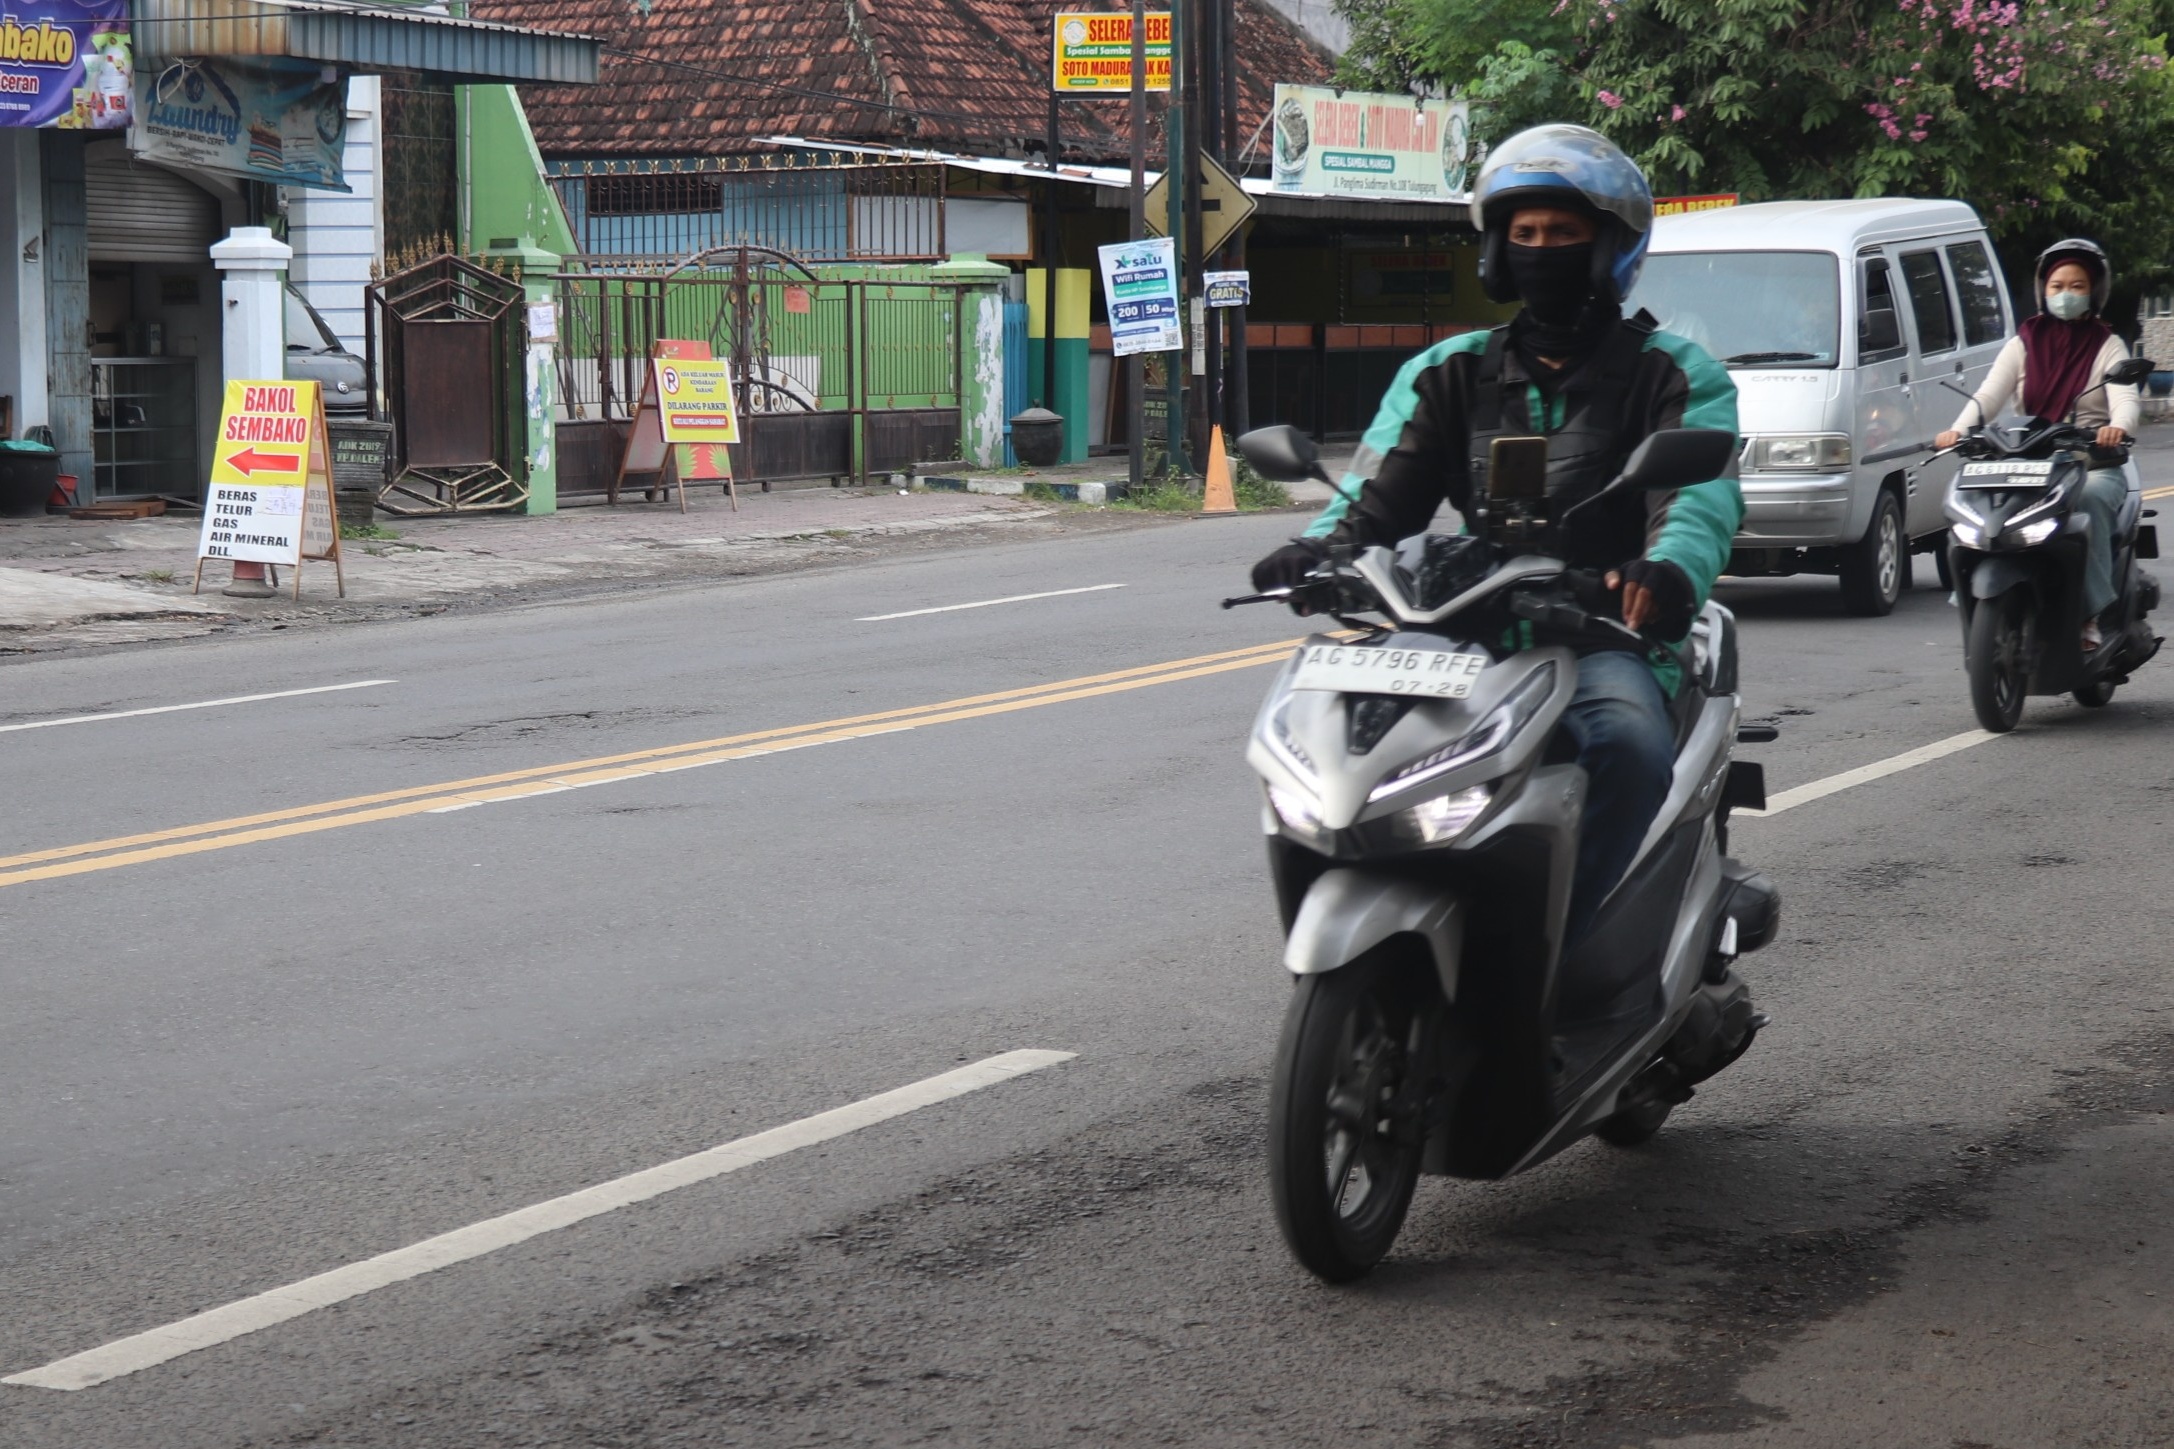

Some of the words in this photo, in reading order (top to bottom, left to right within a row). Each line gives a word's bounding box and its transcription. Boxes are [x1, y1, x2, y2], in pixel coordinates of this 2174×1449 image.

[1067, 46, 1098, 56] Spesial
[1100, 46, 1131, 55] Samba
[1062, 61, 1088, 76] SOTO
[147, 102, 240, 145] Laundry
[1132, 253, 1162, 268] satu
[1116, 274, 1134, 284] Wifi
[1134, 270, 1164, 282] Rumah
[1118, 306, 1138, 318] 200
[1146, 303, 1160, 314] 50
[1751, 375, 1796, 383] CARRY
[1800, 375, 1819, 383] 1.5
[244, 387, 296, 413] BAKOL
[667, 402, 701, 411] DILARANG
[702, 402, 728, 411] PARKIR
[226, 416, 306, 444] SEMBAKO
[217, 489, 258, 502] BERAS
[215, 503, 253, 516] TELUR
[213, 517, 239, 529] GAS
[209, 531, 232, 543] AIR
[234, 534, 289, 548] MINERAL
[208, 545, 232, 557] DLL.
[1307, 647, 1343, 666] AG
[1352, 649, 1423, 671] 5796
[1428, 653, 1485, 676] RFE
